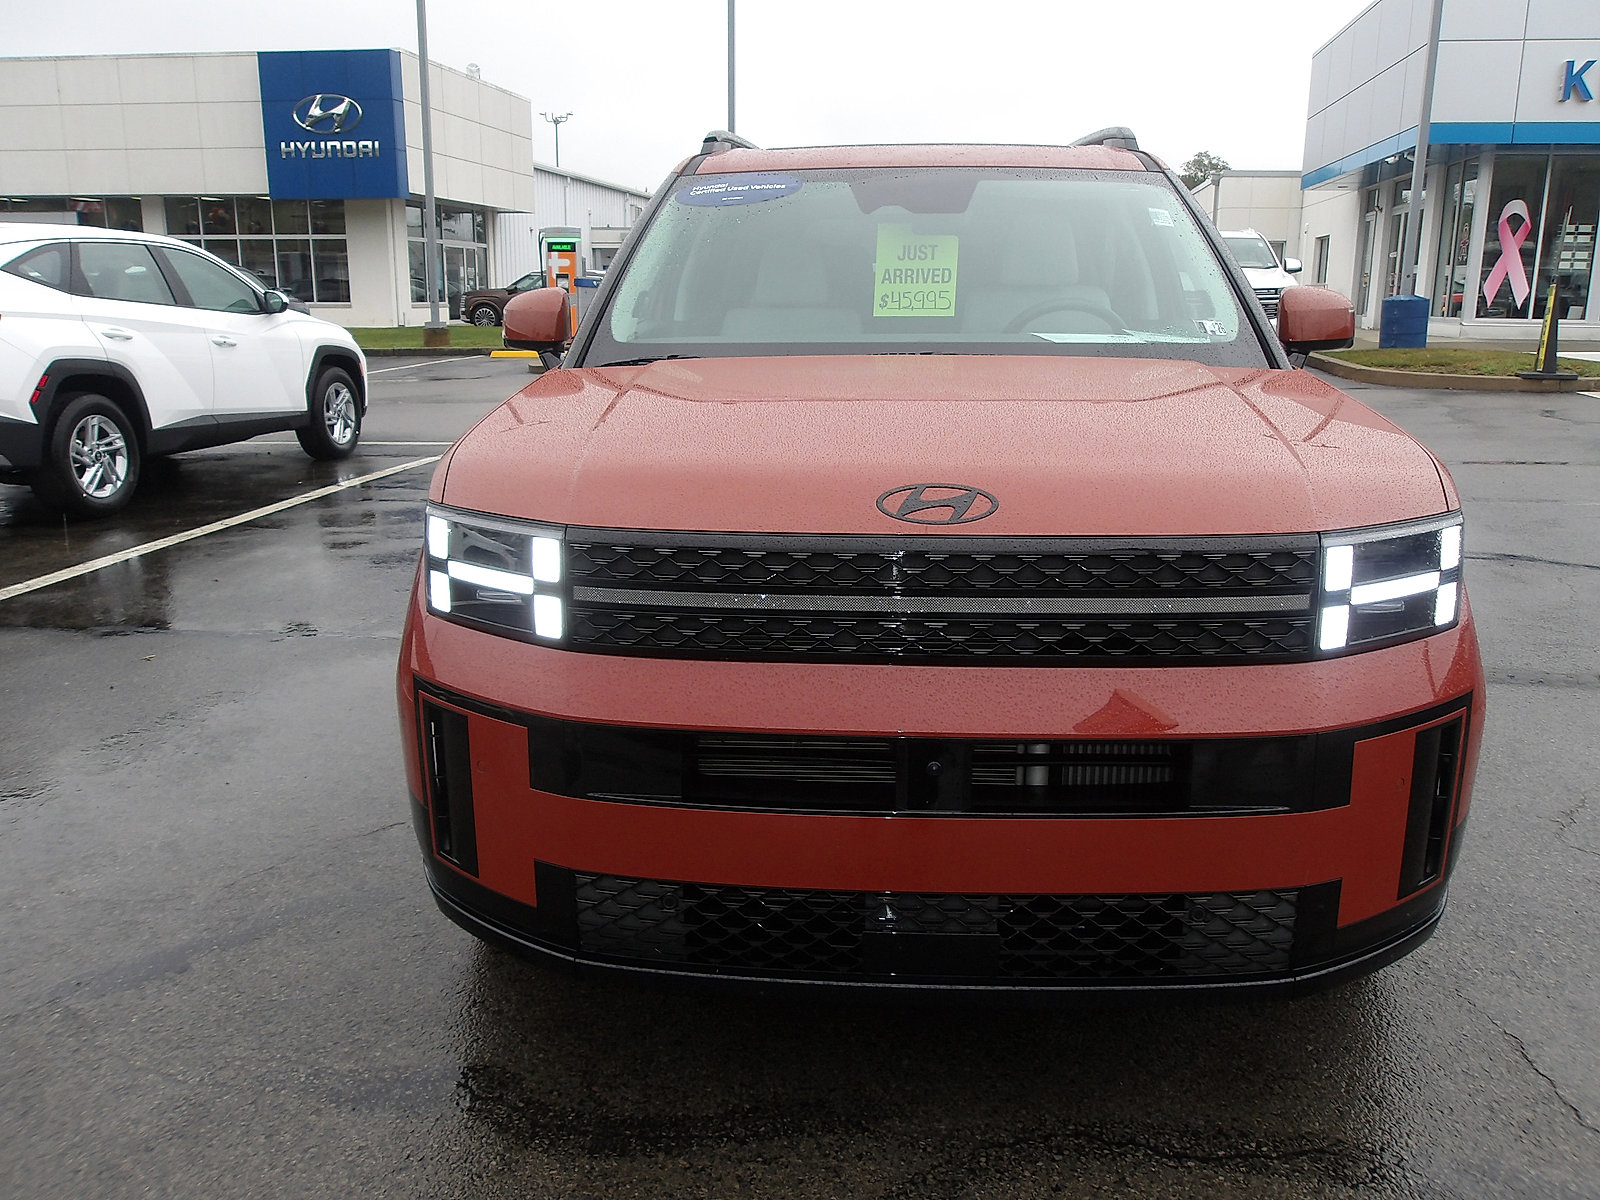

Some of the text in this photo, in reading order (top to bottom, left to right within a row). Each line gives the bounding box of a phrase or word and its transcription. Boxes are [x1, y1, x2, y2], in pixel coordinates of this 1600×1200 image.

[1559, 59, 1597, 102] K
[280, 141, 380, 159] HYUNDAI
[689, 188, 727, 196] Certified
[692, 182, 729, 191] Hyundai
[897, 244, 939, 261] JUST
[880, 267, 952, 285] ARRIVED
[879, 290, 952, 311] $45,995
